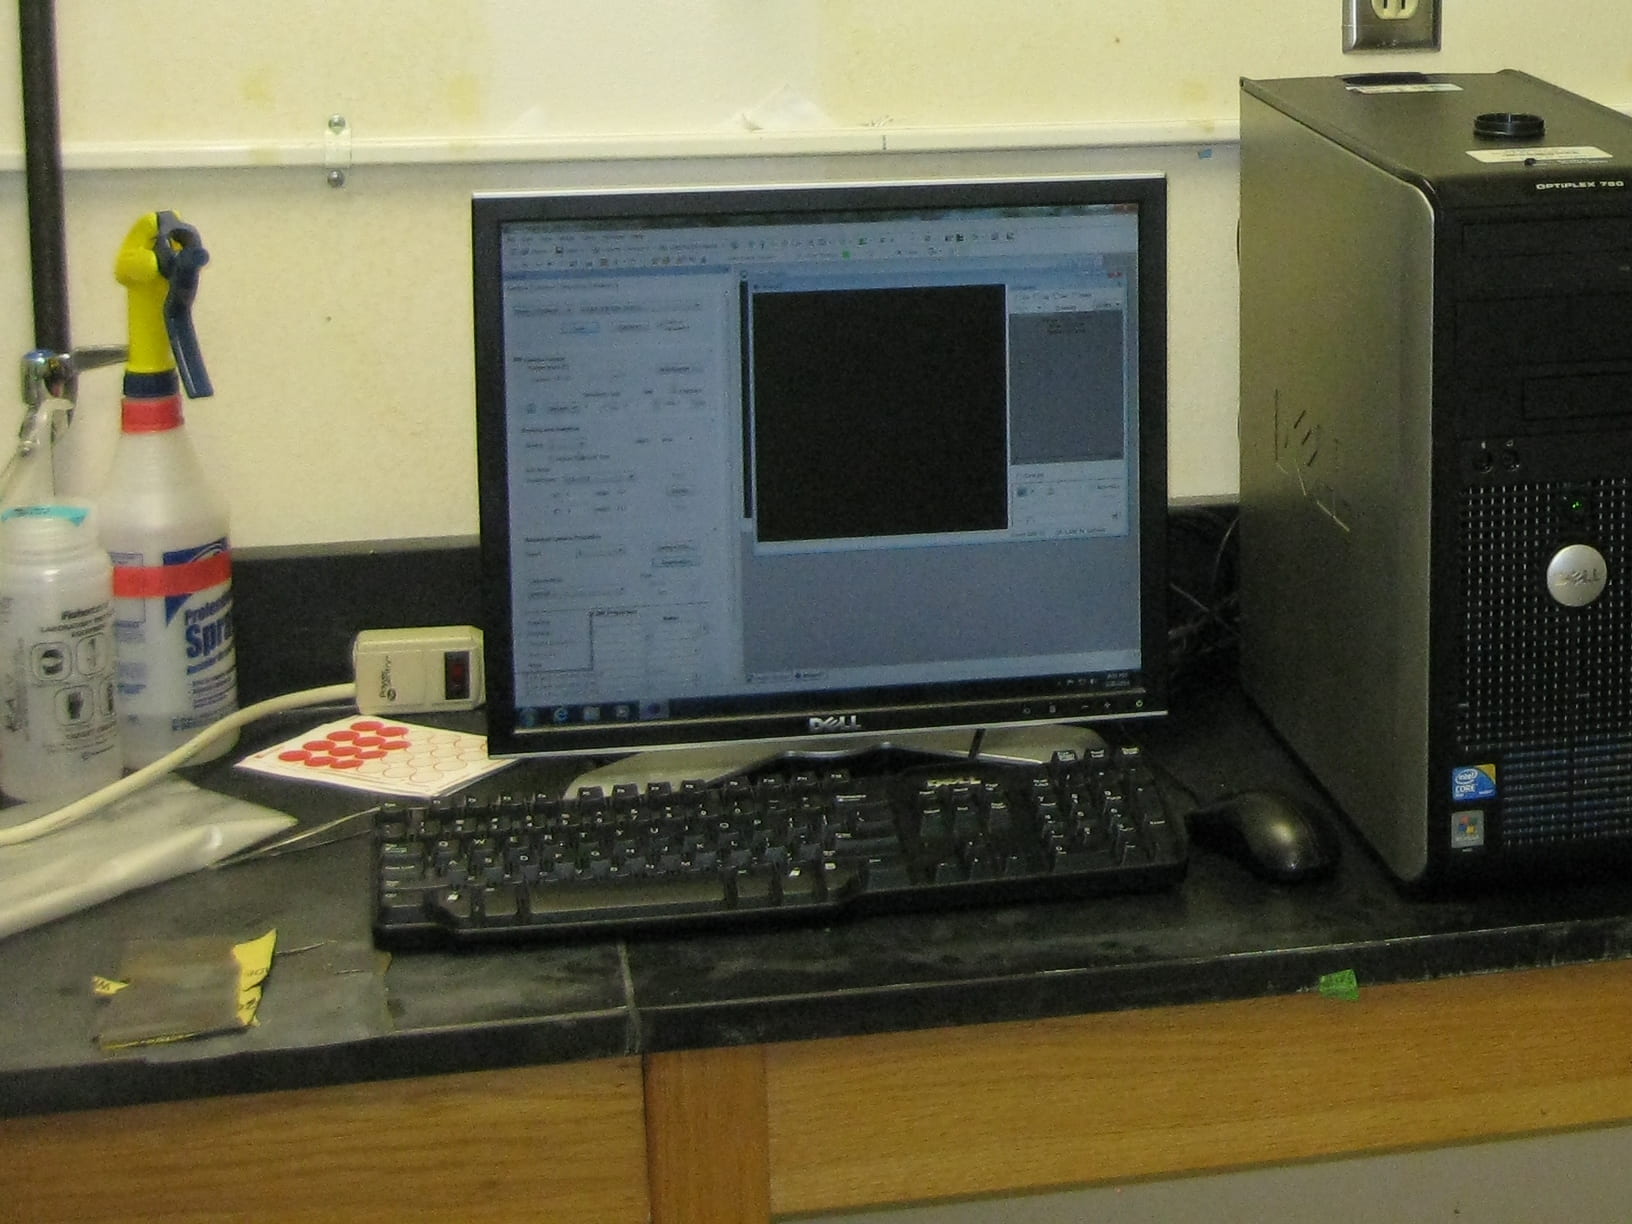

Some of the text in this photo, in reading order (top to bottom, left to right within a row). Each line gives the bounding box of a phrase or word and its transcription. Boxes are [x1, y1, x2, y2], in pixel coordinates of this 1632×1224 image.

[1535, 181, 1596, 191] OPTIPLEX
[808, 715, 862, 733] DELL
[1455, 784, 1476, 793] CORE
